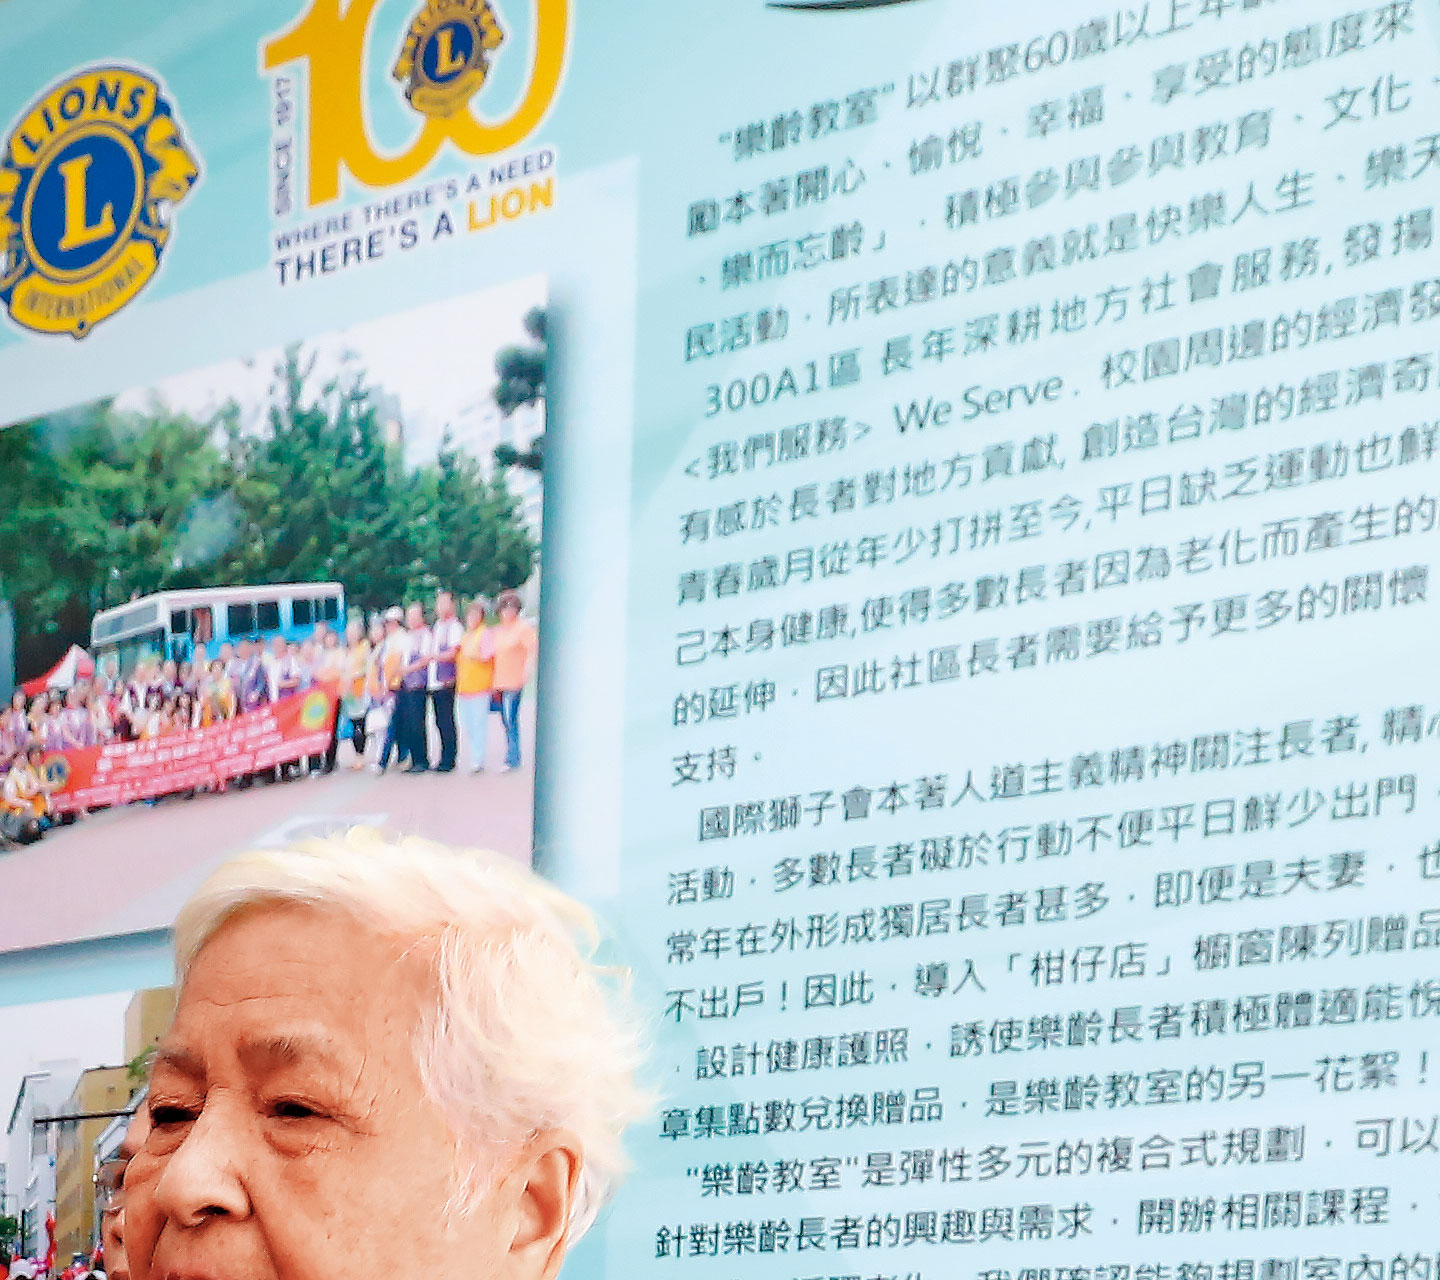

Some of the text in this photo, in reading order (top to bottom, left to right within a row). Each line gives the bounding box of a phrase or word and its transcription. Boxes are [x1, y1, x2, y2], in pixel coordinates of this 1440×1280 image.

[19, 78, 147, 154] LIONS
[57, 153, 117, 252] L
[275, 211, 353, 251] WHERE
[466, 174, 483, 194] A
[489, 149, 554, 184] NEED
[275, 177, 554, 286] THERE'S A LION
[893, 398, 952, 434] We
